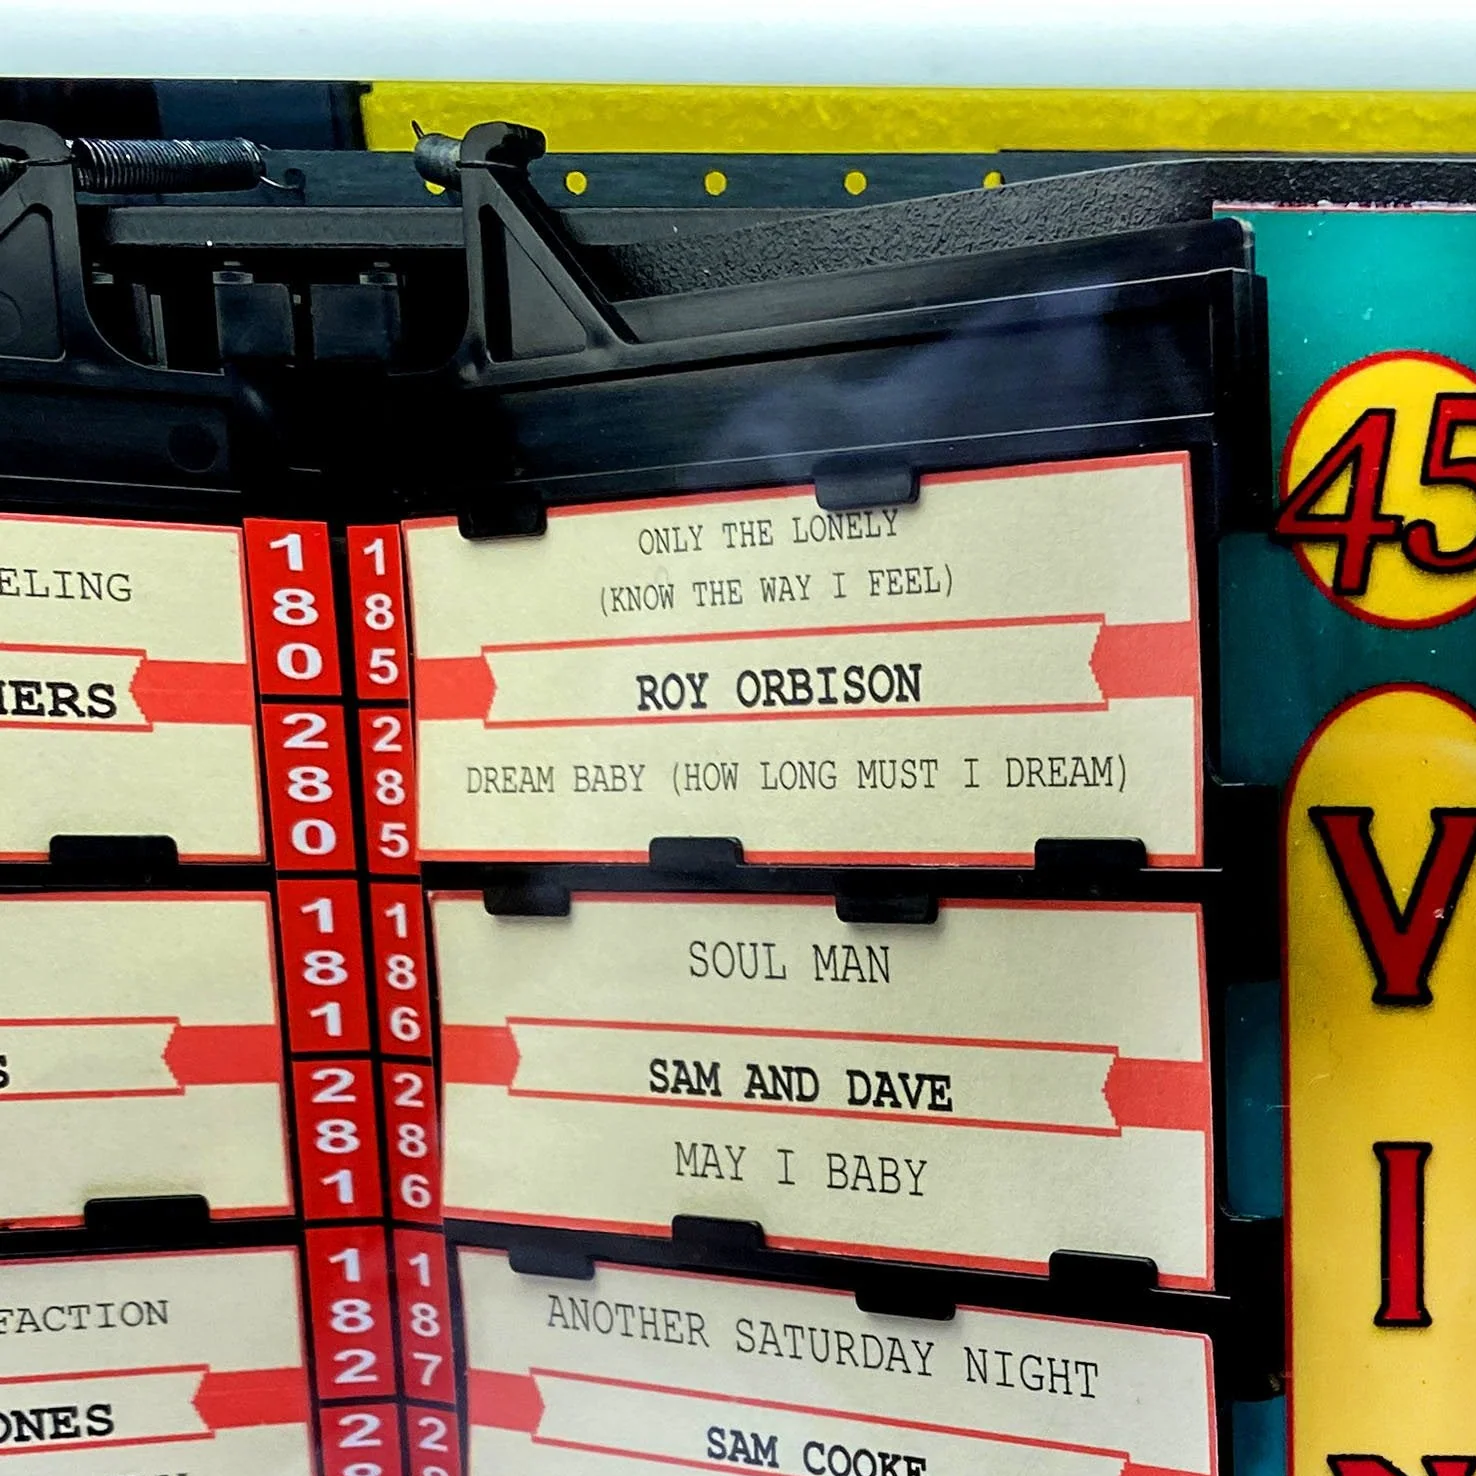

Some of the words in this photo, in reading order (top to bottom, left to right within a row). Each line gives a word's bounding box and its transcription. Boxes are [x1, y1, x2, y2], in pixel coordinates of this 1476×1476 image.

[600, 583, 675, 617] (KNOW
[692, 578, 743, 607] THE
[759, 574, 811, 603] WAY
[832, 572, 847, 599] I
[867, 563, 953, 598] FEEL)
[638, 524, 704, 556] ONLY
[722, 519, 774, 549] THE
[792, 507, 901, 545] LONELY
[269, 533, 323, 680] 180
[363, 538, 404, 685] 185
[635, 671, 709, 712] ROY
[736, 663, 922, 708] ORBISON
[282, 712, 336, 855] 280
[372, 715, 410, 858] 285
[466, 765, 555, 794] DREAM
[573, 763, 646, 793] BABY
[673, 762, 739, 797] (HOW
[759, 759, 837, 791] LONG
[856, 758, 938, 790] MUST
[963, 758, 980, 788] I
[1005, 754, 1126, 793] DREAM)
[301, 897, 348, 1037] 181
[385, 902, 421, 1042] 186
[689, 940, 787, 980] SOUL
[812, 944, 890, 984] MAN
[312, 1067, 360, 1204] 281
[394, 1072, 431, 1209] 286
[649, 1057, 723, 1097] SAM
[743, 1063, 820, 1103] AND
[845, 1069, 953, 1113] DAVE
[674, 1141, 747, 1182] MAY
[776, 1148, 796, 1186] I
[826, 1152, 928, 1197] BABY
[329, 1248, 378, 1384] 182
[409, 1252, 443, 1386] 187
[547, 1293, 710, 1348] ANOTHER
[736, 1316, 935, 1377] SATURDAY
[963, 1346, 1099, 1399] NIGHT
[707, 1426, 780, 1469] SAM
